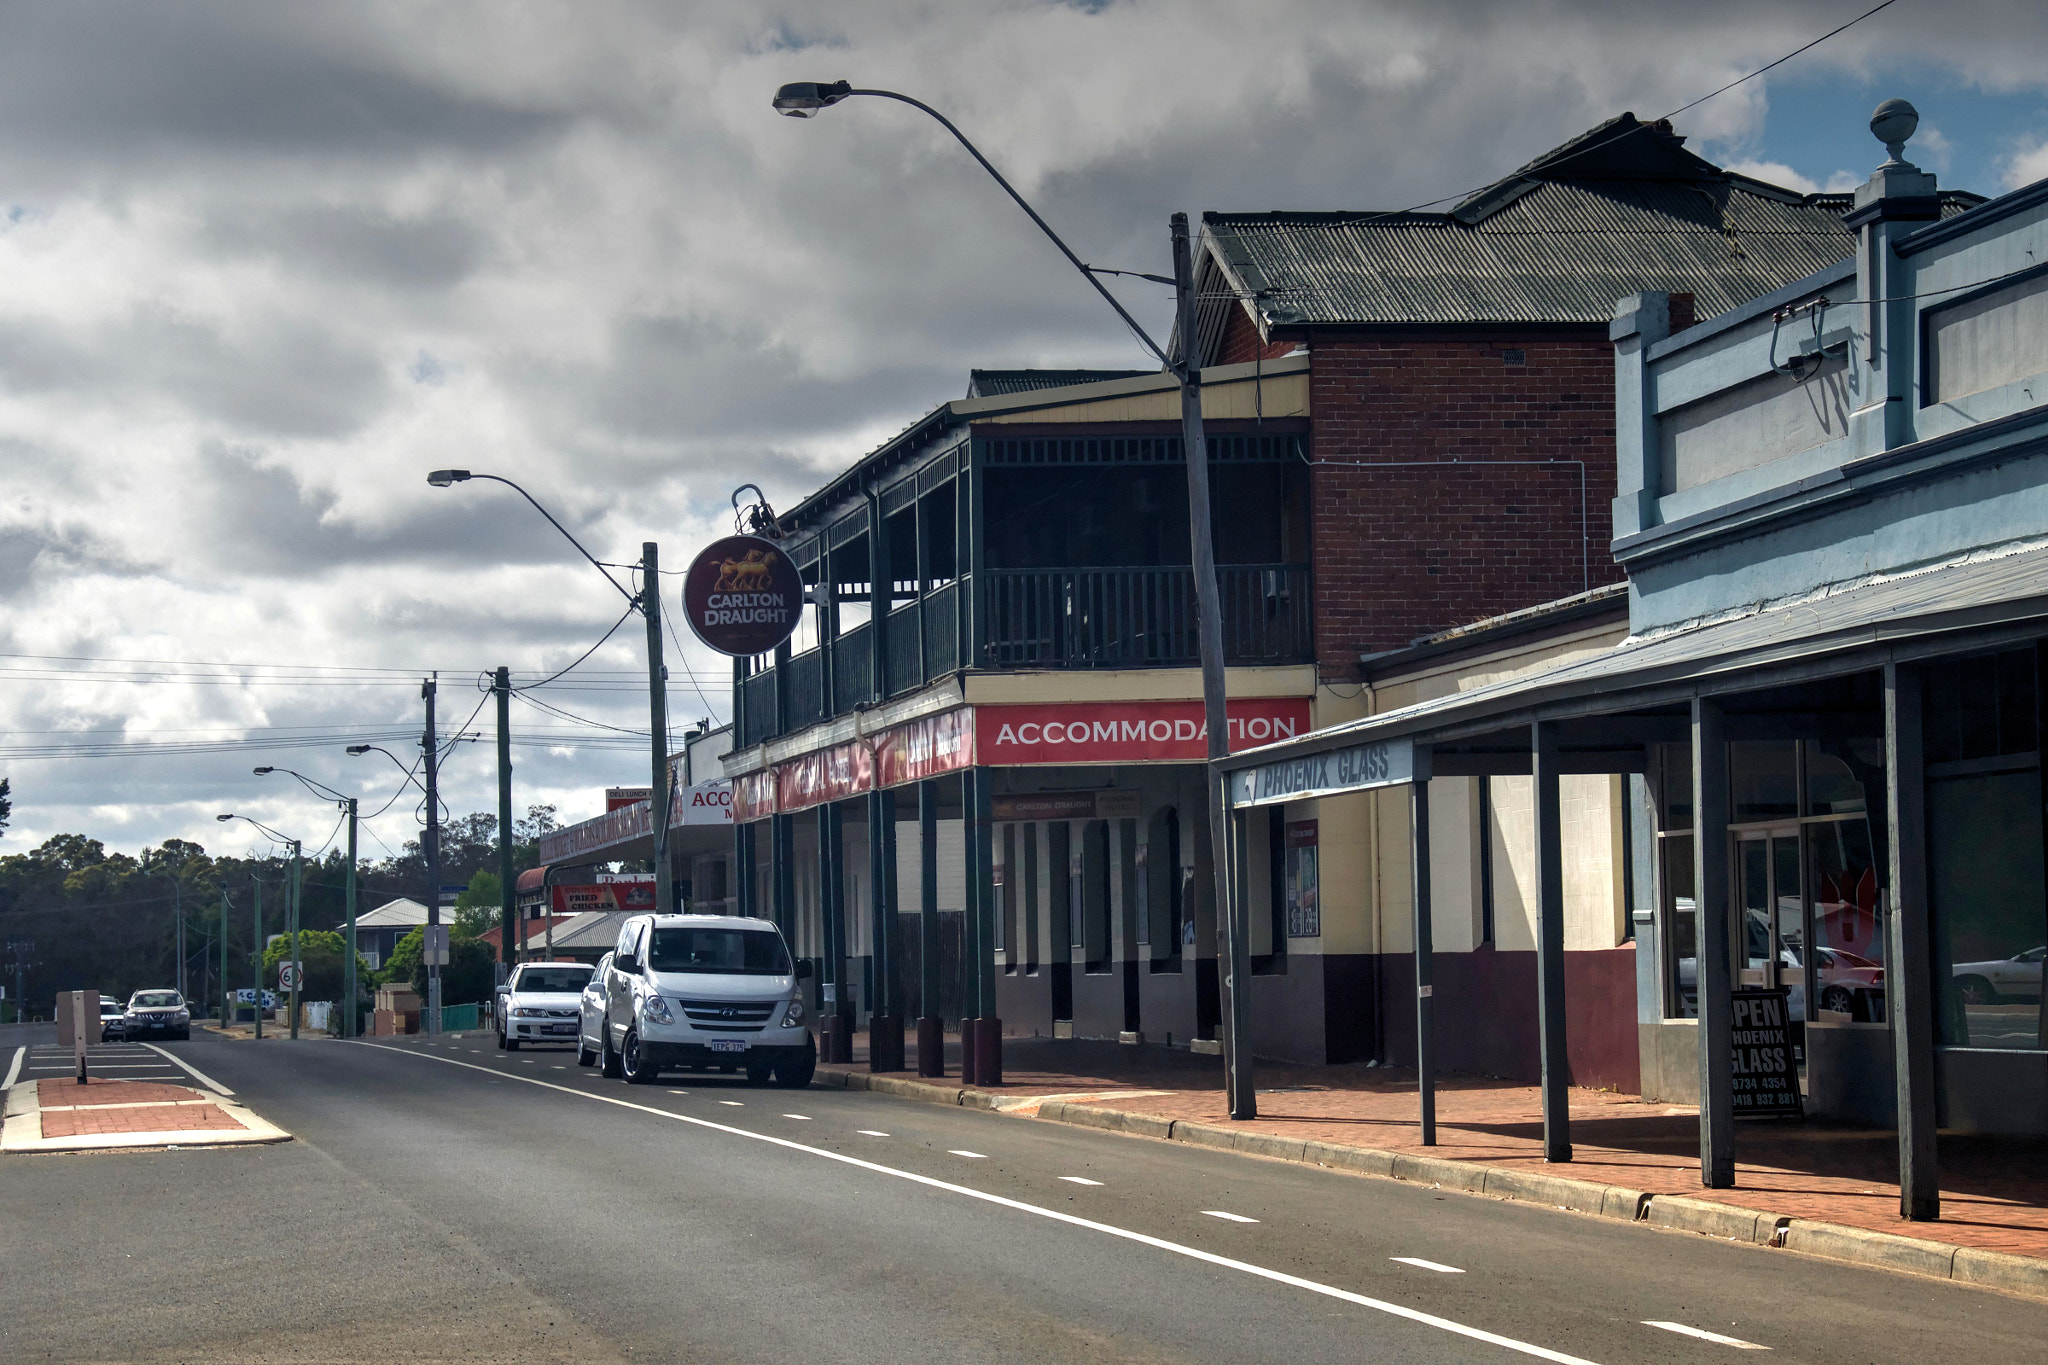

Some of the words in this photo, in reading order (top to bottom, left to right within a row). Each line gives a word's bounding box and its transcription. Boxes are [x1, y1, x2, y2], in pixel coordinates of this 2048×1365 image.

[707, 593, 784, 609] CARLTON
[704, 608, 788, 626] DRAUGHT
[1264, 756, 1329, 797] PHOENIX
[1338, 745, 1389, 784] GLASS
[692, 791, 733, 806] ACC
[1016, 802, 1052, 811] CARLTON
[569, 894, 598, 902] FRIED
[571, 902, 614, 910] CHICKEN
[1732, 998, 1781, 1027] PEN
[1733, 1029, 1785, 1045] HOENIX
[1732, 1047, 1787, 1074] GLASS
[1733, 1078, 1757, 1090] 9734
[1762, 1077, 1787, 1089] 4354
[1756, 1093, 1774, 1105] 932
[1778, 1093, 1795, 1105] 881
